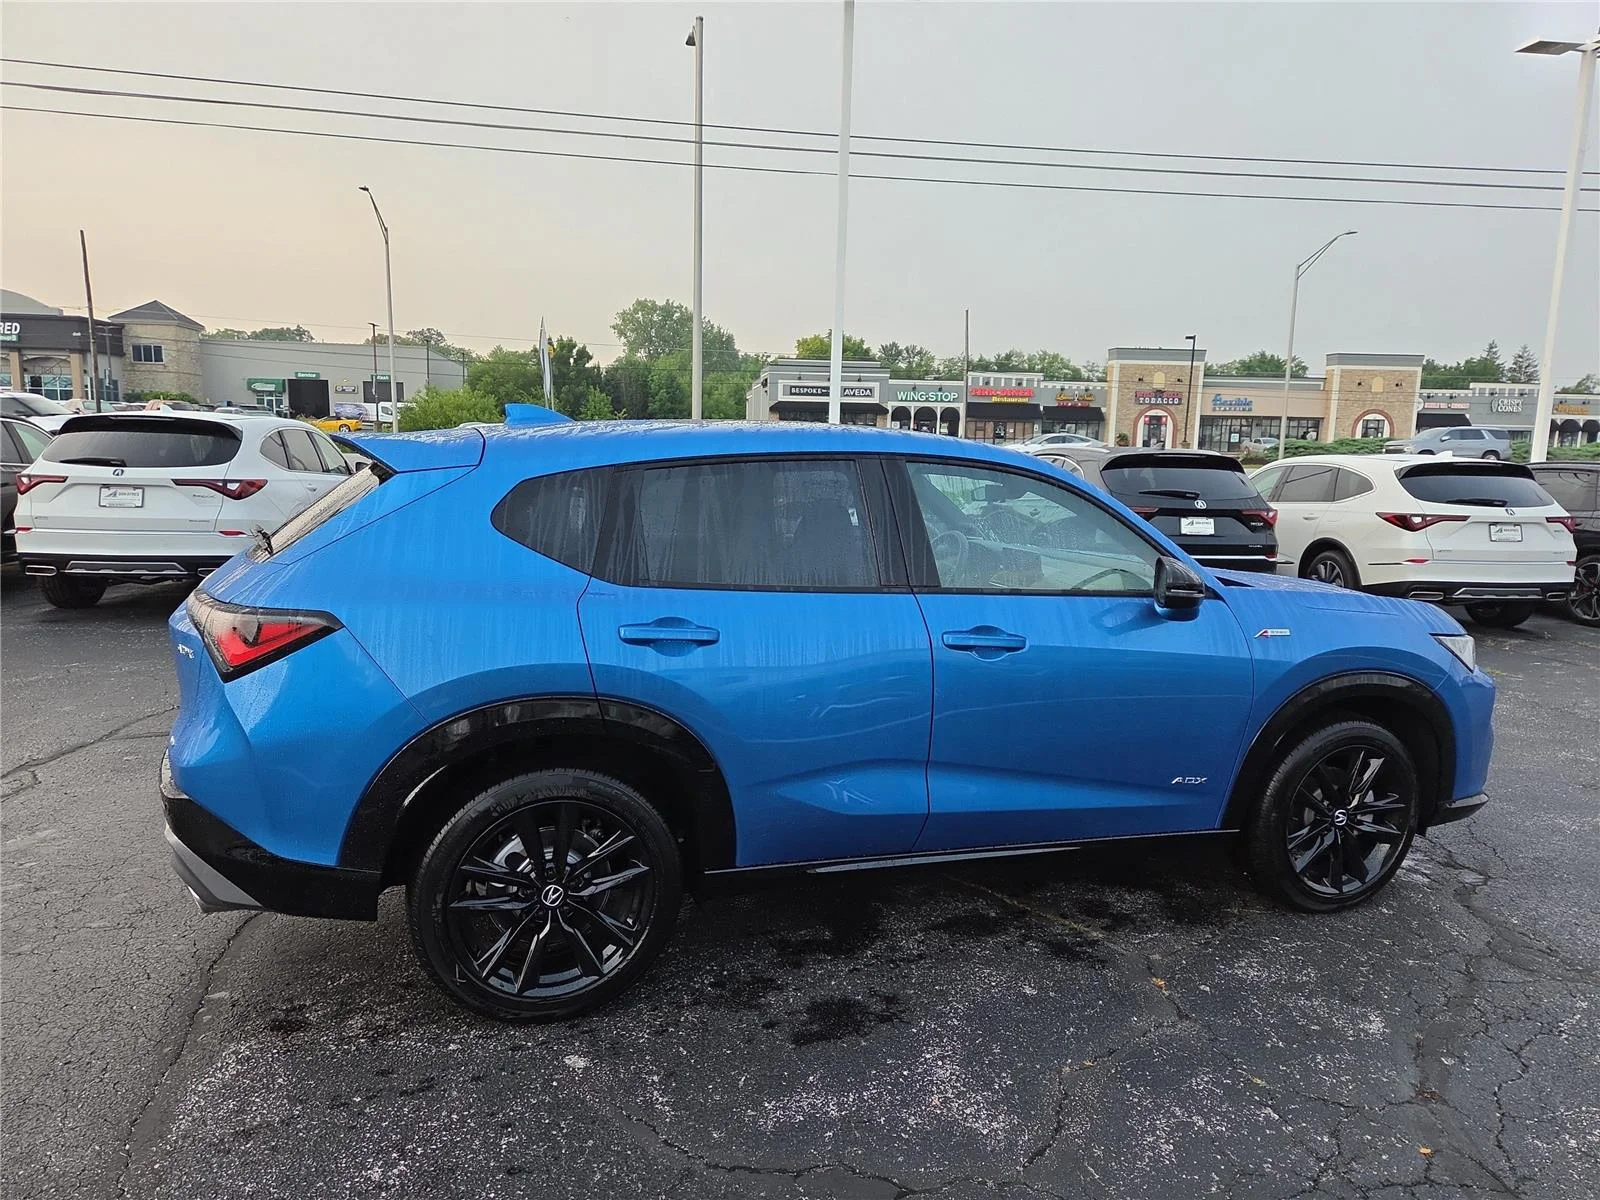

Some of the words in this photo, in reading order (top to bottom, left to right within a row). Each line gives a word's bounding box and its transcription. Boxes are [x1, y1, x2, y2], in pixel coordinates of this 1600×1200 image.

[843, 388, 872, 396] AVEDA
[1498, 398, 1524, 406] CRISPY
[1171, 776, 1208, 784] ADX
